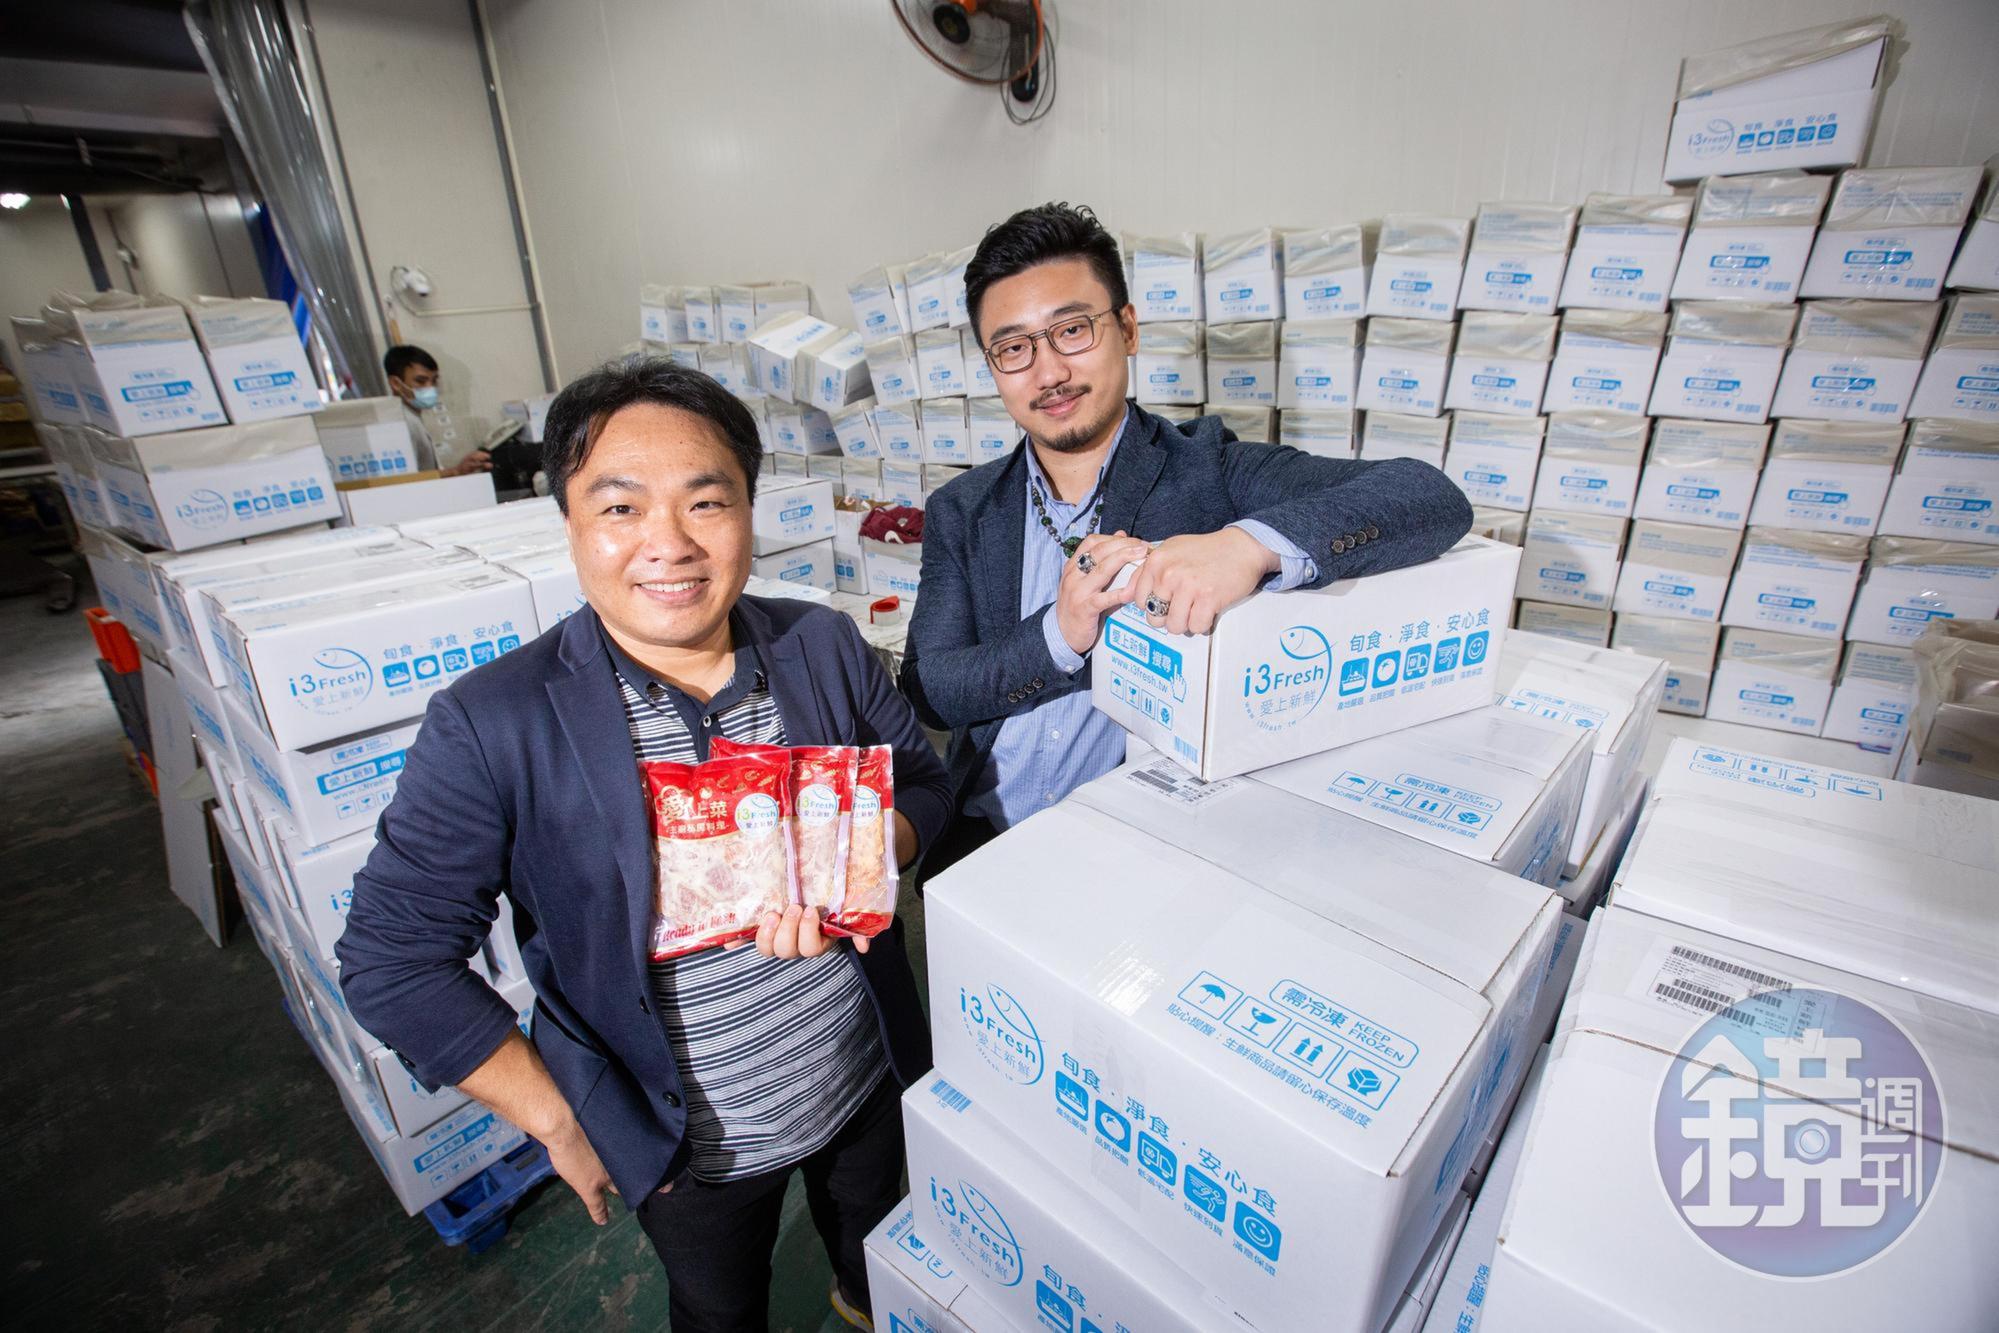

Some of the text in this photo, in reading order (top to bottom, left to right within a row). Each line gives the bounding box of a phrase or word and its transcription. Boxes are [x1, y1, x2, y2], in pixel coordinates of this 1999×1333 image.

[288, 670, 367, 697] i3Fresh
[1244, 663, 1325, 698] i3Fresh
[960, 986, 1036, 1064] i3Fresh
[1281, 987, 1349, 1030] 需冷凍
[1348, 1028, 1406, 1063] FROZEN
[1353, 1021, 1393, 1043] KEEP
[930, 1176, 1015, 1268] i3Fresh
